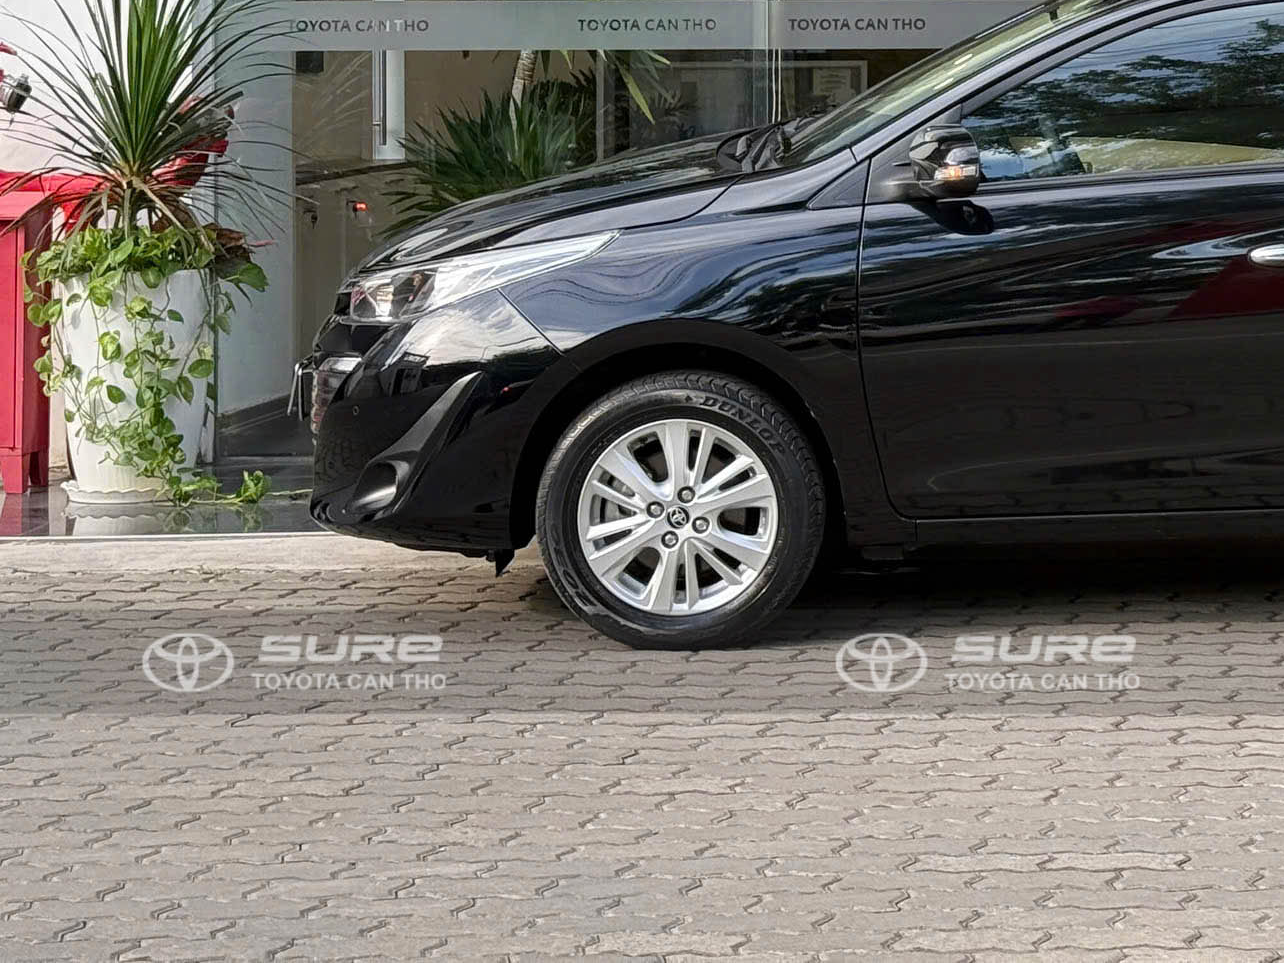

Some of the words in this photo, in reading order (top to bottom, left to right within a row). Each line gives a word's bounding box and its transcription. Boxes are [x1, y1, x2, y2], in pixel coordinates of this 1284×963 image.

[577, 19, 641, 31] TOYOTA
[645, 19, 678, 31] CAN
[682, 19, 716, 31] THO
[788, 18, 850, 30] TOYOTA
[854, 18, 888, 30] CAN
[892, 18, 926, 30] THO
[699, 394, 786, 454] DUNLOP
